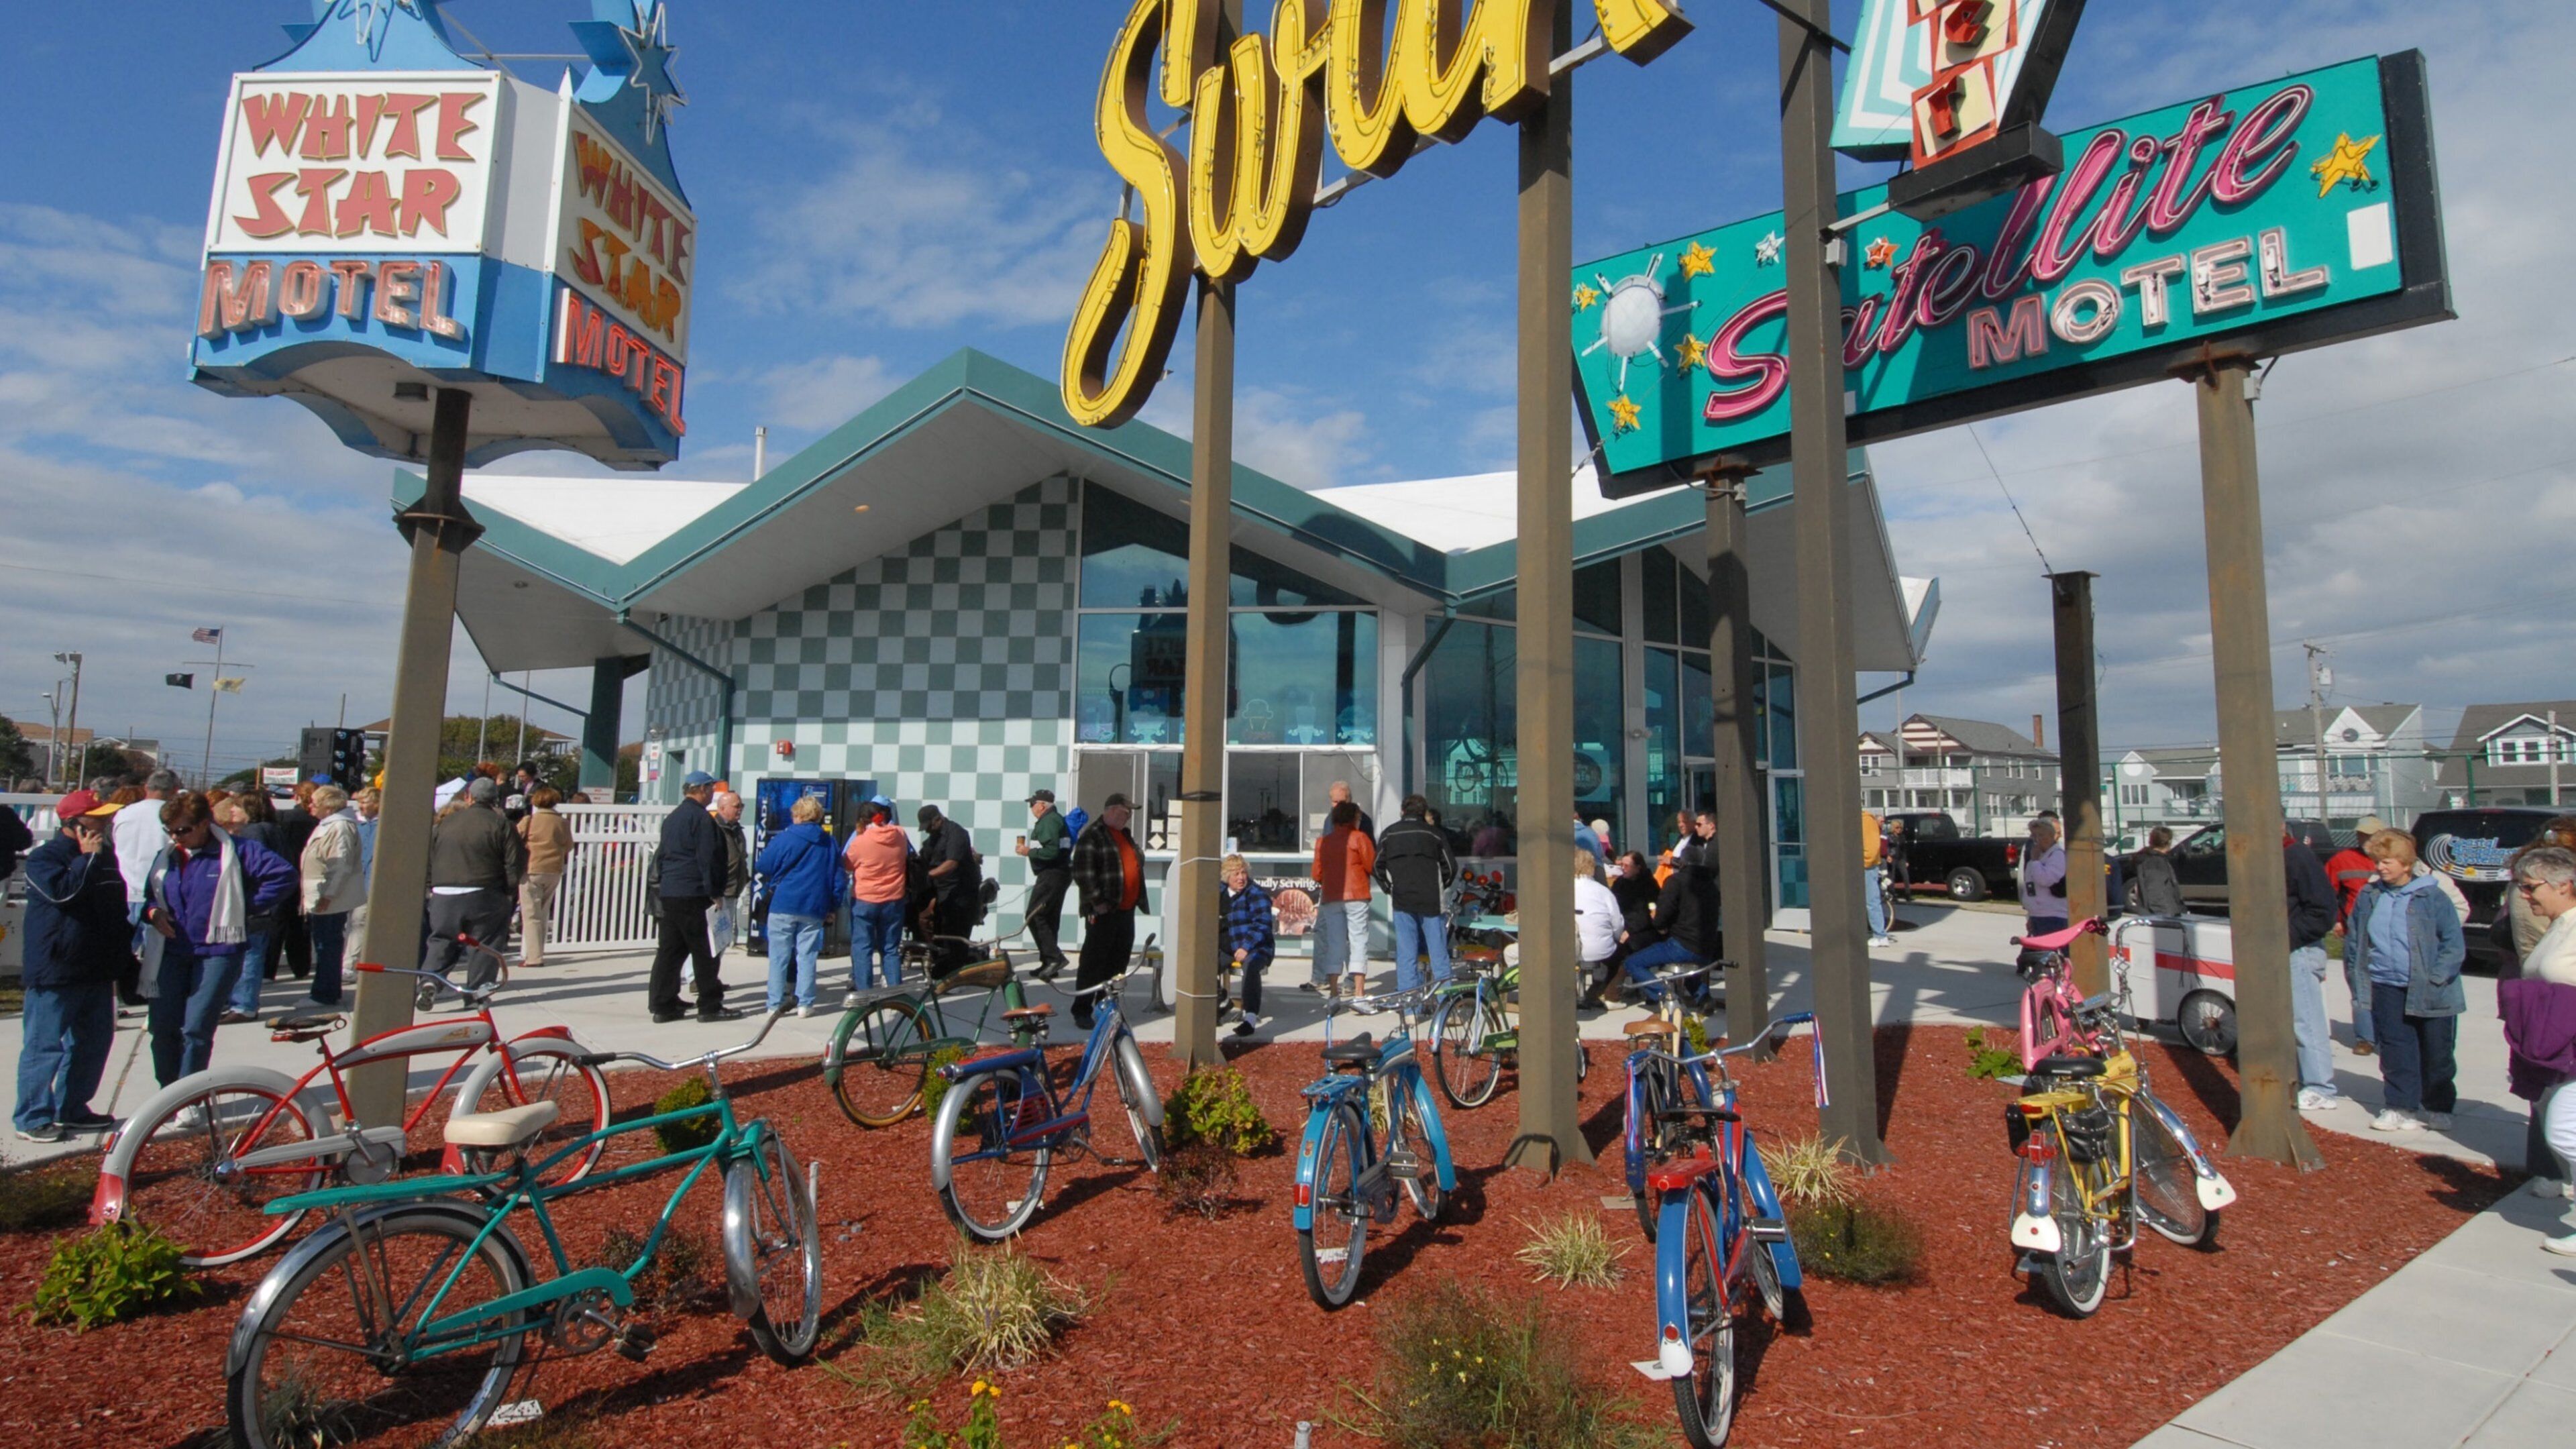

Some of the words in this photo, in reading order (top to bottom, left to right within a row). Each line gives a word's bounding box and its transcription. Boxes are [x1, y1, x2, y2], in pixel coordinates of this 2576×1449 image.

[241, 92, 488, 162] WHITE
[233, 167, 462, 239] STAR
[572, 130, 693, 286] WHITE
[1703, 83, 2315, 421] Satellite
[197, 258, 466, 341] MOTEL
[569, 217, 682, 343] STAR
[1966, 226, 2330, 370] MOTEL
[565, 286, 686, 437] MOTEL
